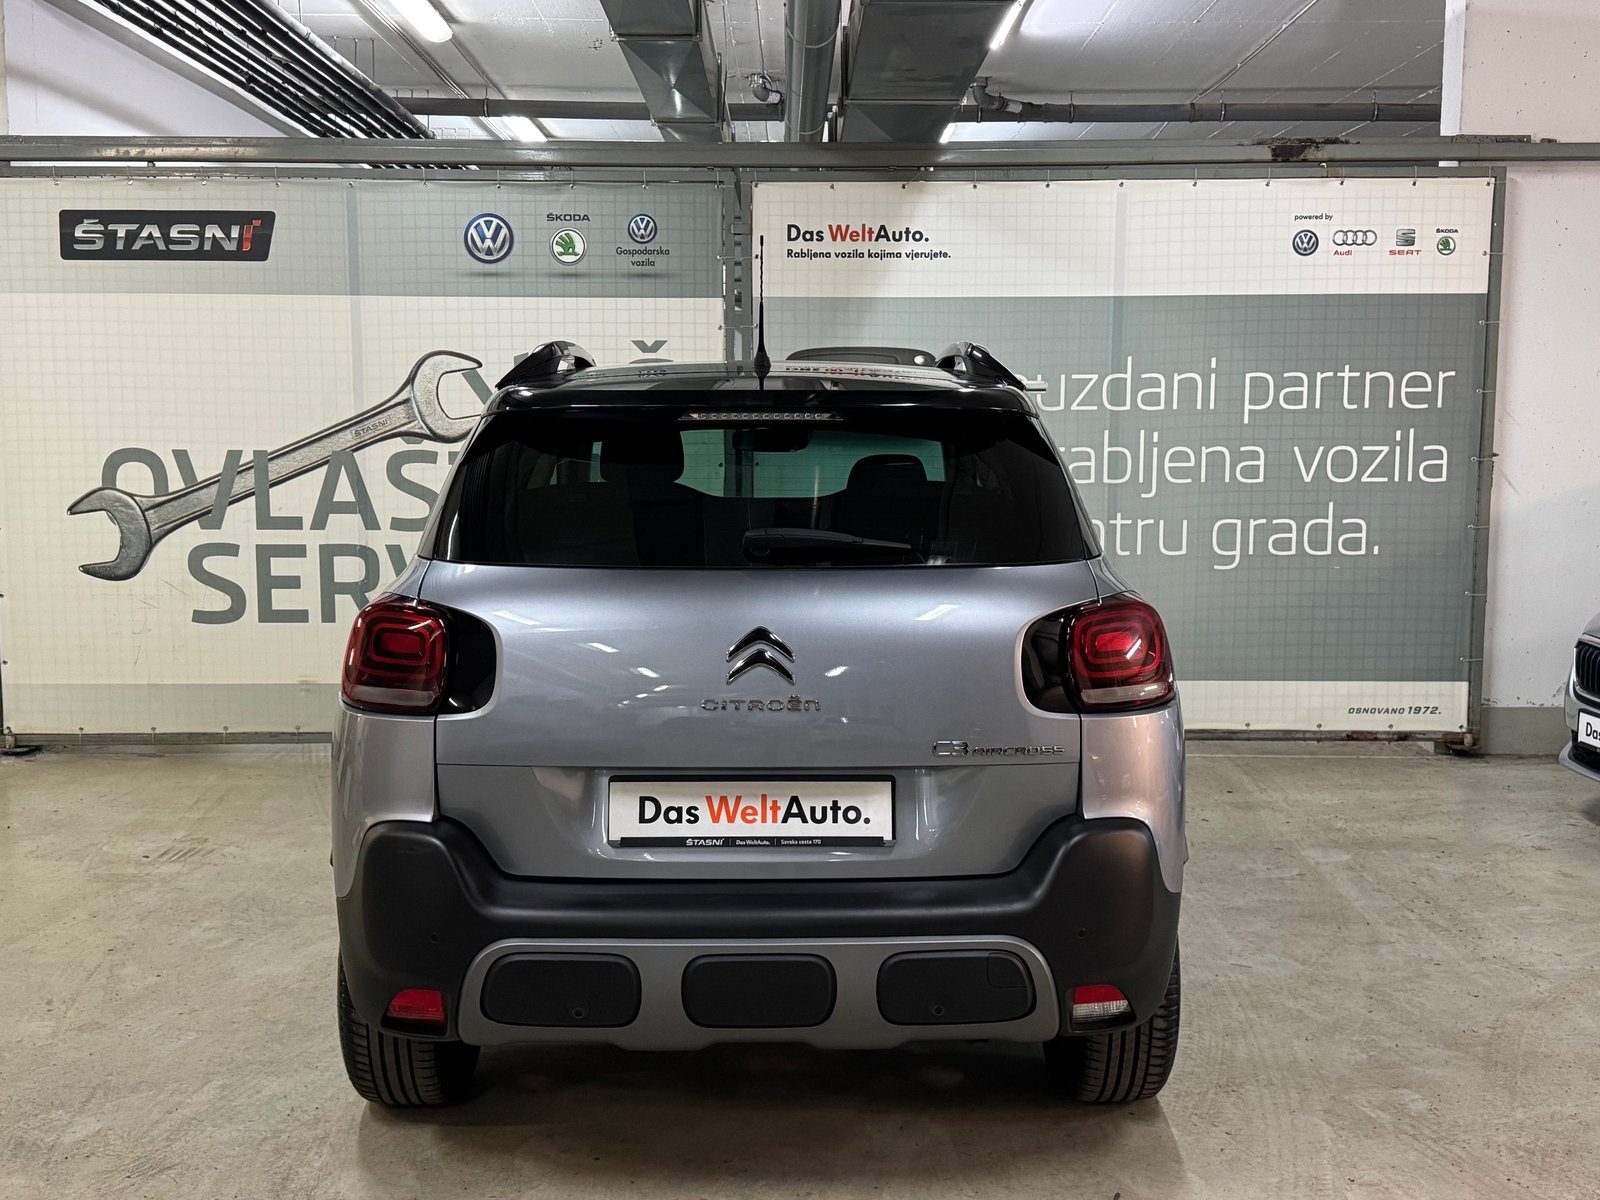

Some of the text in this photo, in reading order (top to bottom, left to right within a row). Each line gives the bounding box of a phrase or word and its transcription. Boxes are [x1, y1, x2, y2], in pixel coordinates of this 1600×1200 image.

[546, 212, 591, 222] ŠKODA
[1294, 213, 1334, 221] powered by
[786, 223, 930, 242] Das WeltAuto.
[616, 246, 670, 257] Gospodarska
[786, 248, 951, 261] Rabljena vozila kojima vjerujete.
[631, 258, 655, 267] vozila
[1014, 356, 1456, 425] uzdani partner
[1058, 428, 1448, 498] abljena vozila
[1211, 501, 1379, 570] grada.
[1348, 706, 1442, 715] OSNOVANO 1972.
[1585, 722, 1600, 740] Da
[932, 740, 1065, 757] C3 AIRCROSS
[638, 793, 871, 825] Das WeltAuto.
